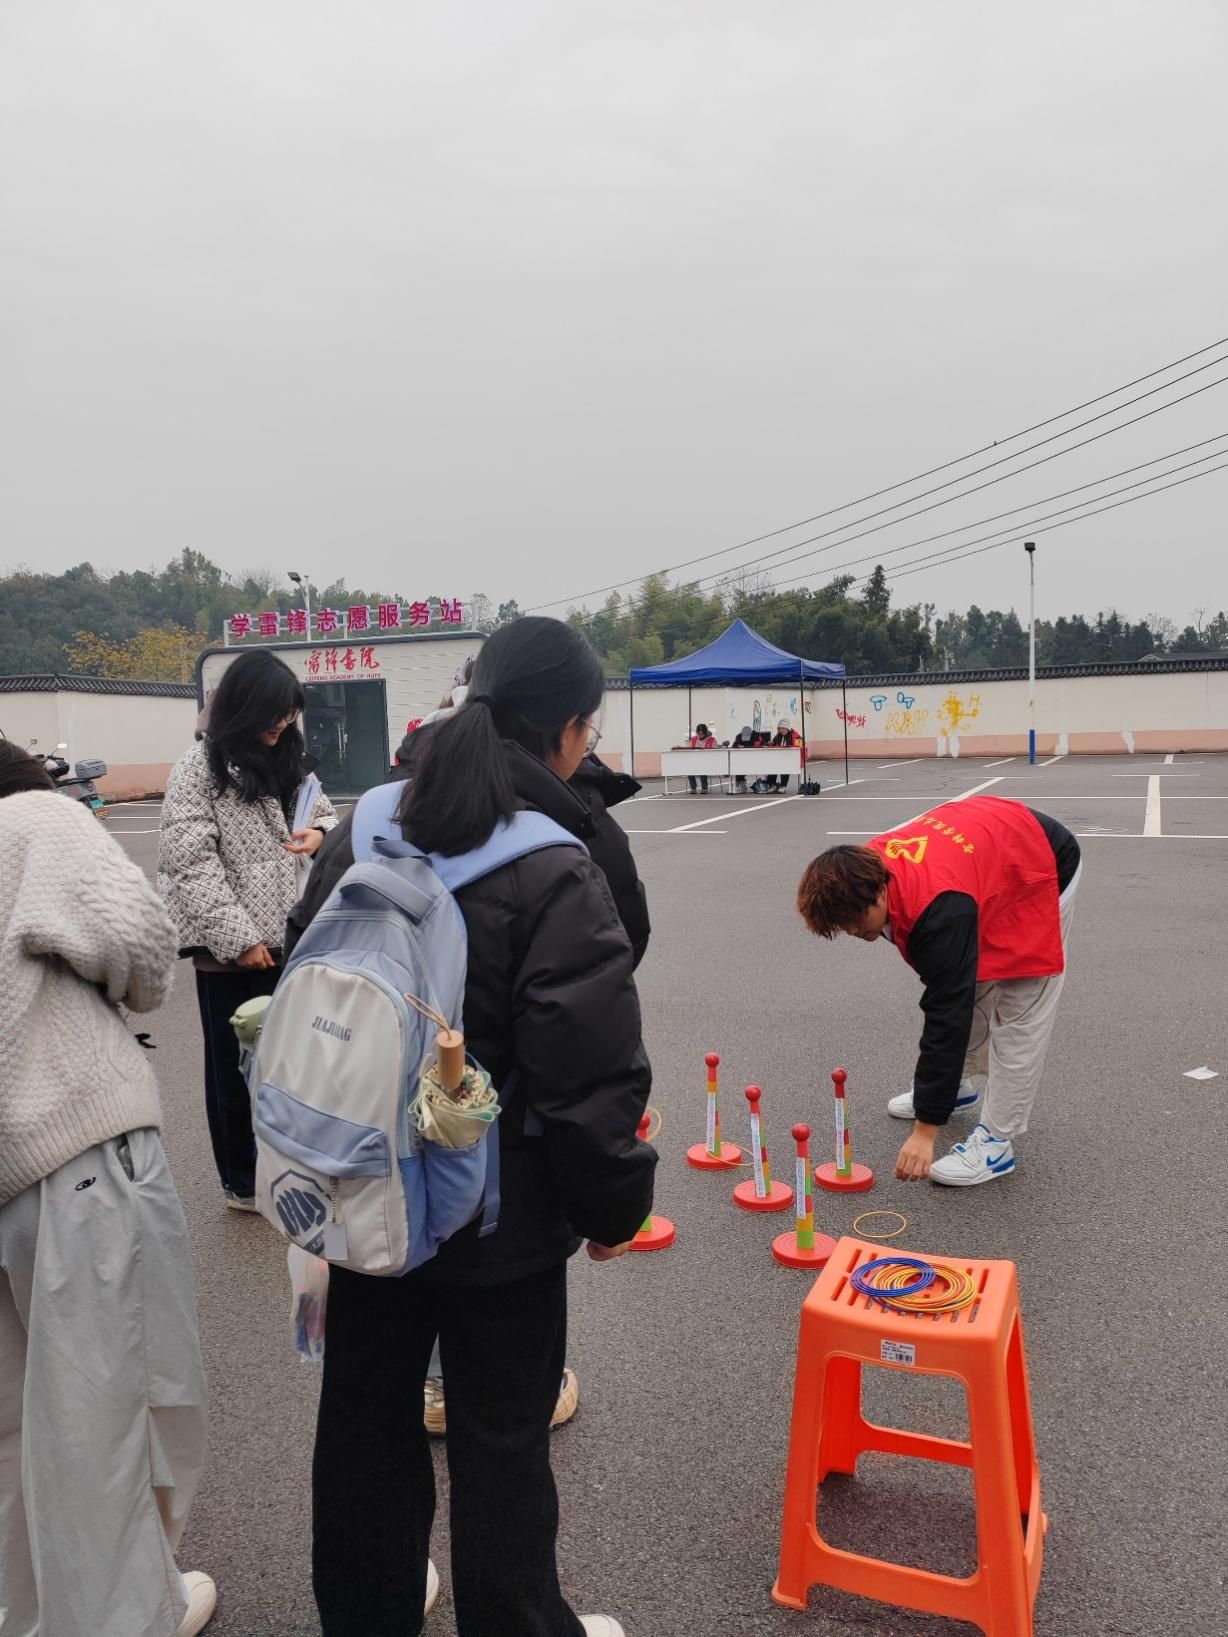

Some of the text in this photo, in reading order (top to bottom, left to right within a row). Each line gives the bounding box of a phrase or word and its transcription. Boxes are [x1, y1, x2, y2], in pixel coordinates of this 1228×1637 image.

[231, 598, 464, 637] 学雷锋志愿服务站
[304, 646, 380, 673] 雷锋书院
